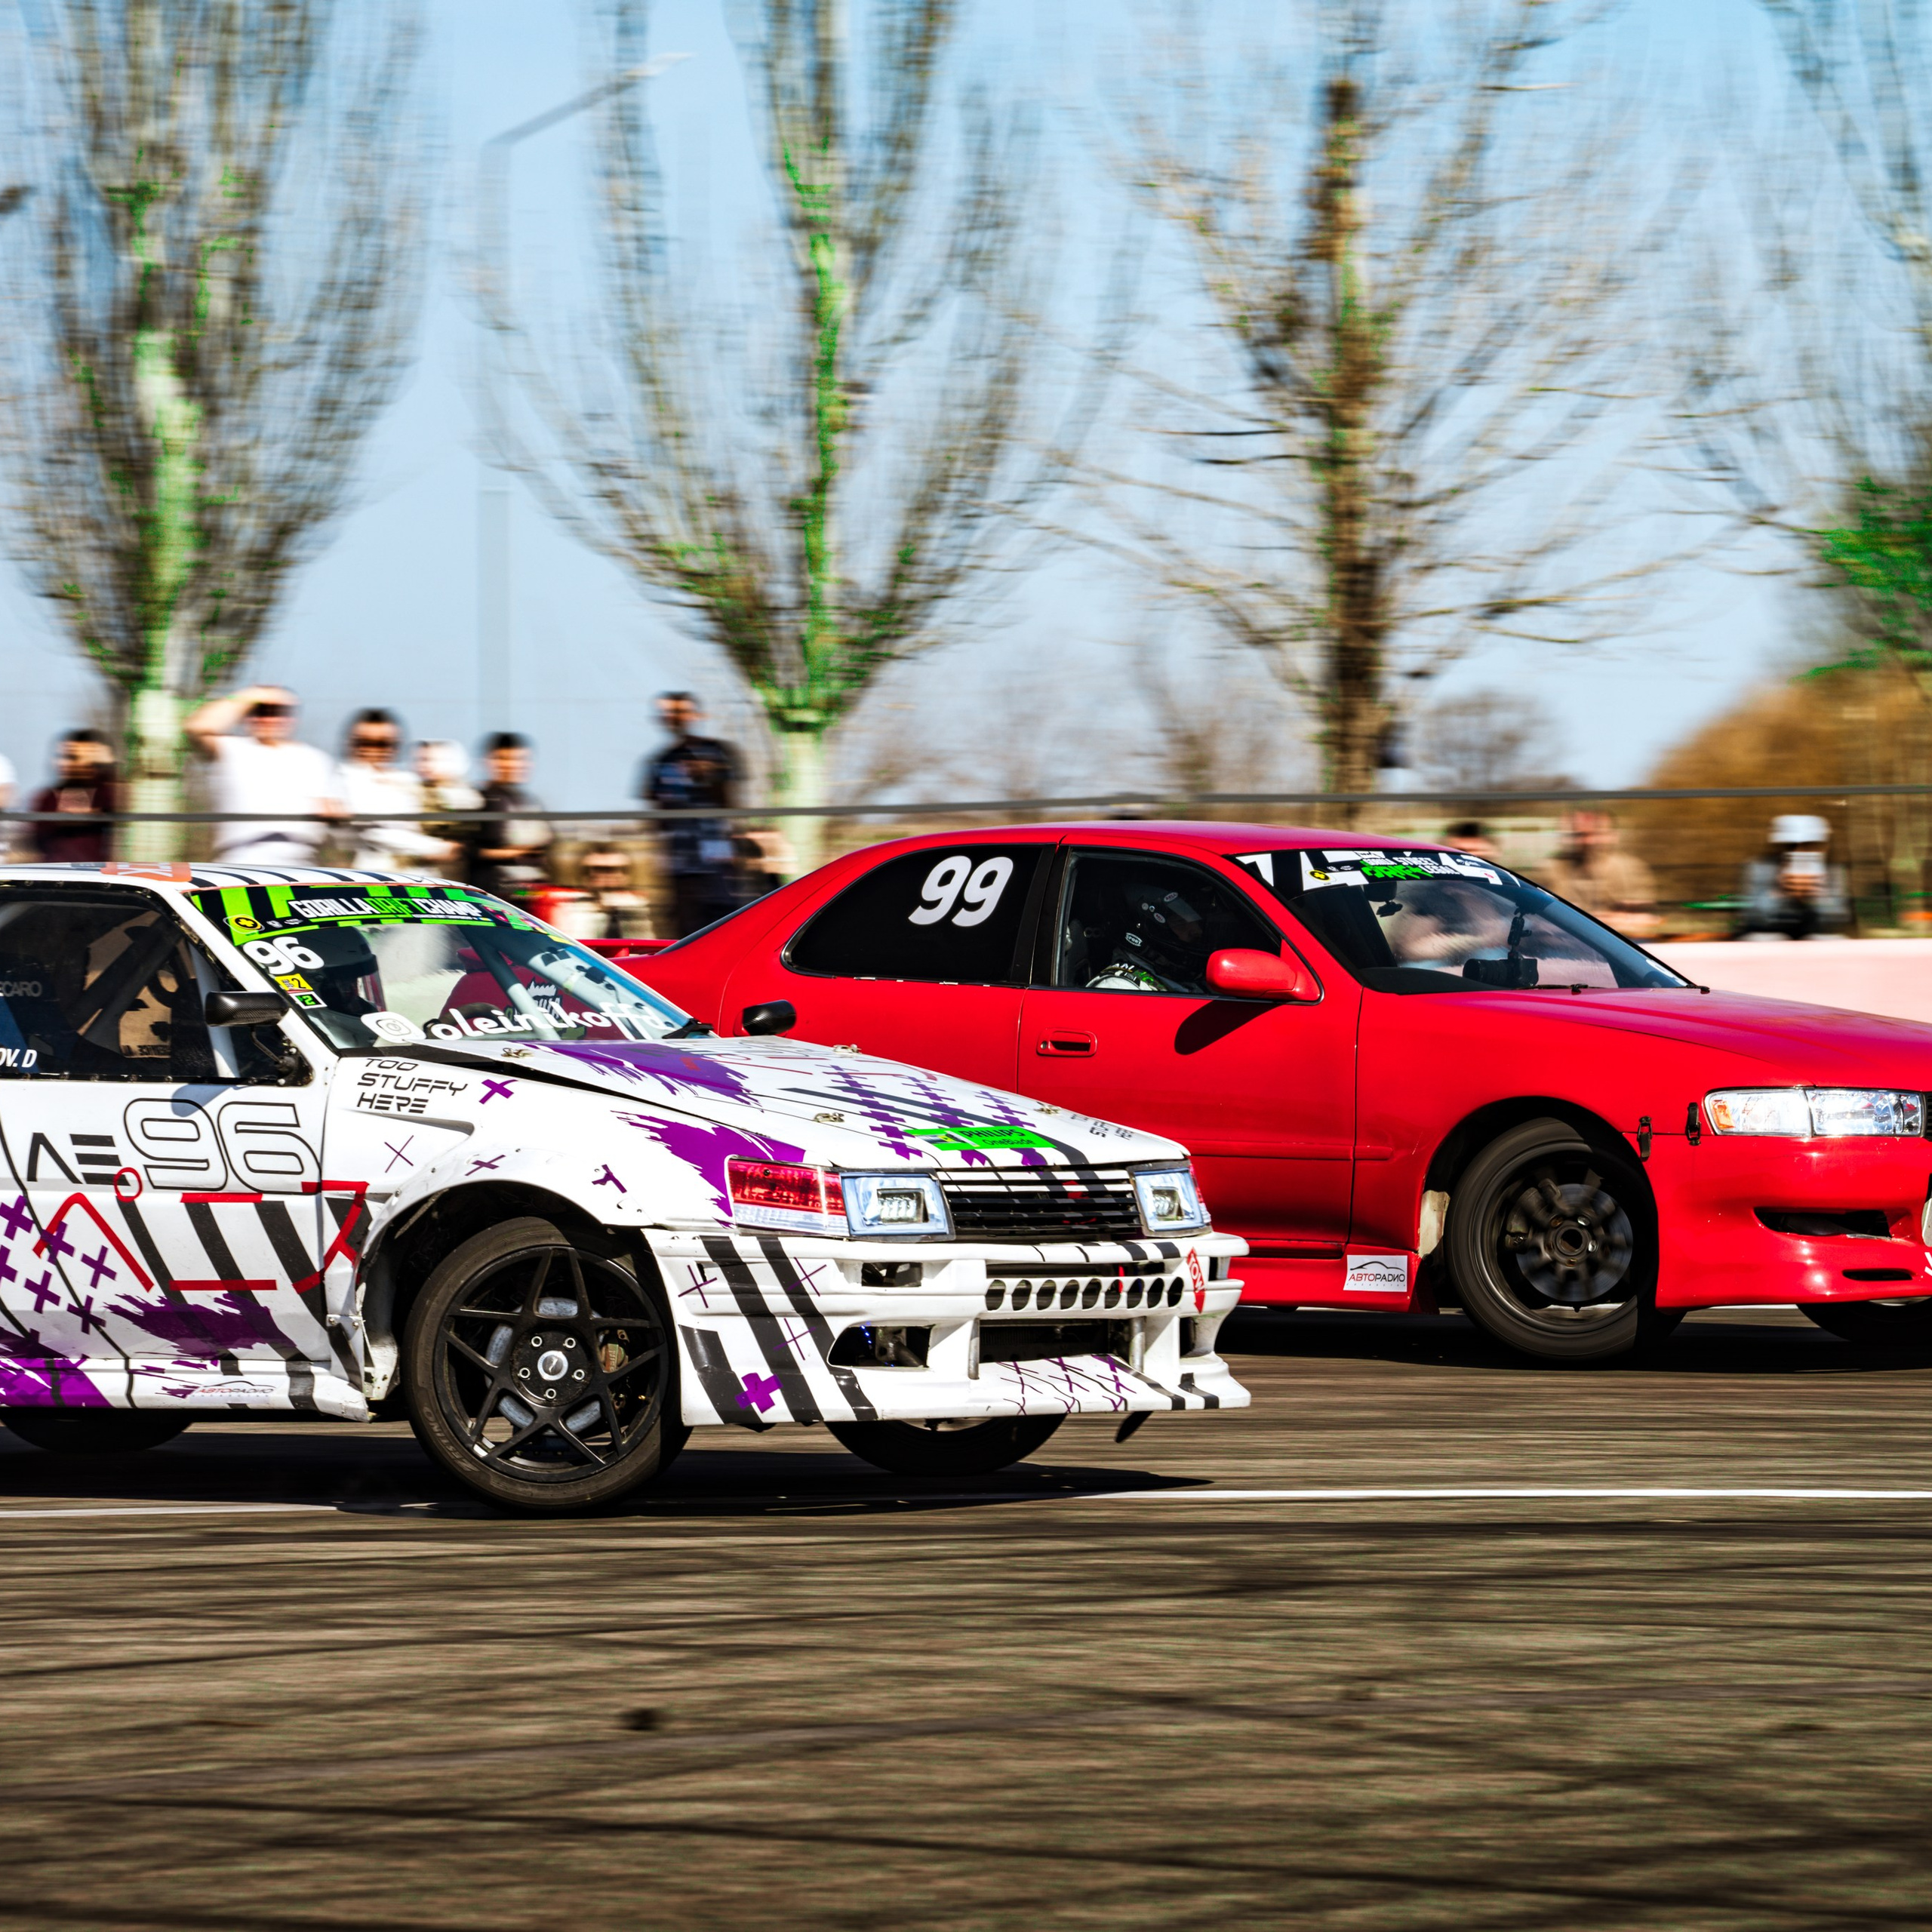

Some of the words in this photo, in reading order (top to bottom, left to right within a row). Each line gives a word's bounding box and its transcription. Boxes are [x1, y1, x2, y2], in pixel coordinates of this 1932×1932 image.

[1392, 857, 1440, 866] STREET
[908, 855, 1014, 928] 99
[1126, 934, 1142, 945] SPORT
[243, 937, 325, 974] 96
[21, 1049, 38, 1068] D
[365, 1058, 419, 1071] TOO
[357, 1072, 468, 1096] STUFFY
[357, 1092, 429, 1114] HERE
[958, 1128, 1026, 1139] PHILIPS
[982, 1138, 1036, 1147] OneBlade
[1189, 1253, 1206, 1294] TOW
[424, 1405, 480, 1472] ZESTINO
